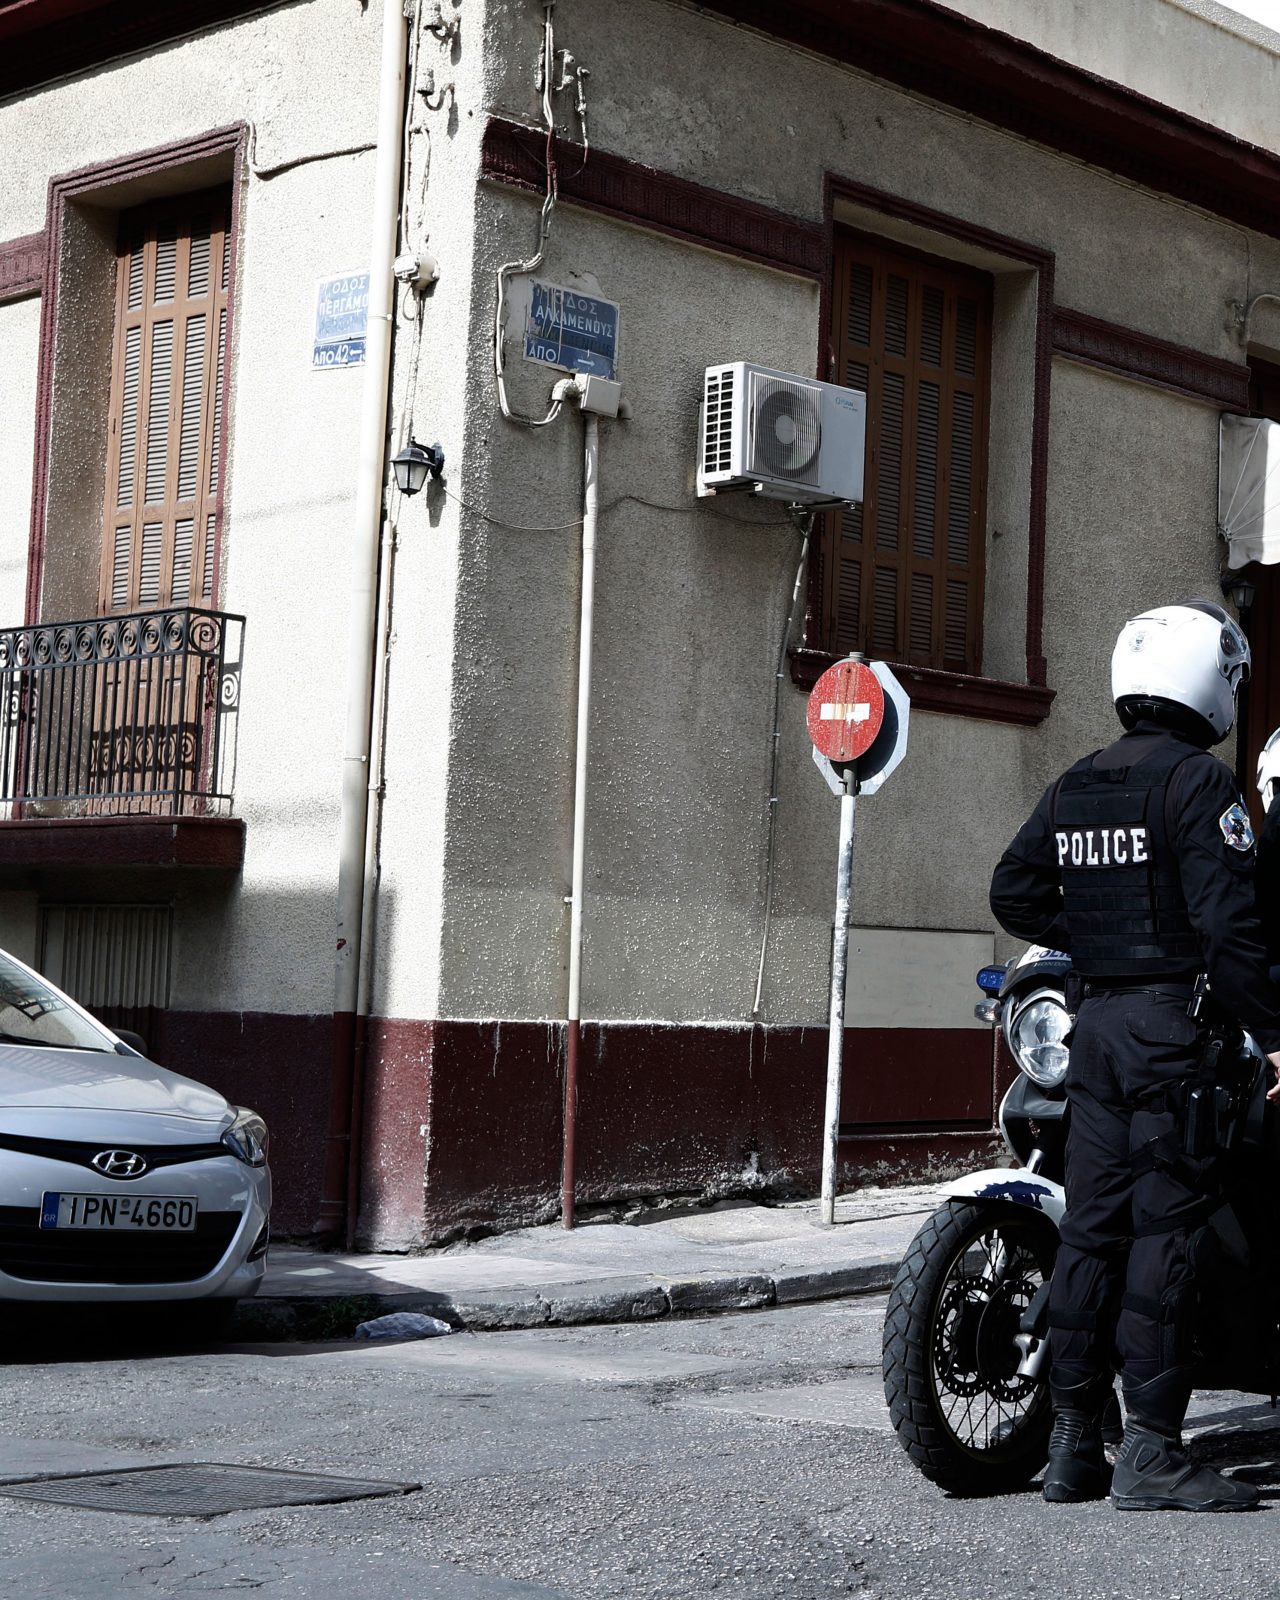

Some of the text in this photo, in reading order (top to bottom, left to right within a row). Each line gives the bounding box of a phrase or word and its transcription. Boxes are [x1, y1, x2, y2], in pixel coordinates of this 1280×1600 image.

[332, 276, 366, 294] ΟΔΟΣ
[319, 293, 368, 316] ΠΕΡΓΑΜΟ
[535, 305, 613, 338] ΑΛΚΑΜΕΝΟΥΣ
[528, 345, 557, 362] ΑΠΟ
[1055, 827, 1149, 866] POLICE
[1029, 950, 1071, 960] POLI
[43, 1215, 56, 1223] GR
